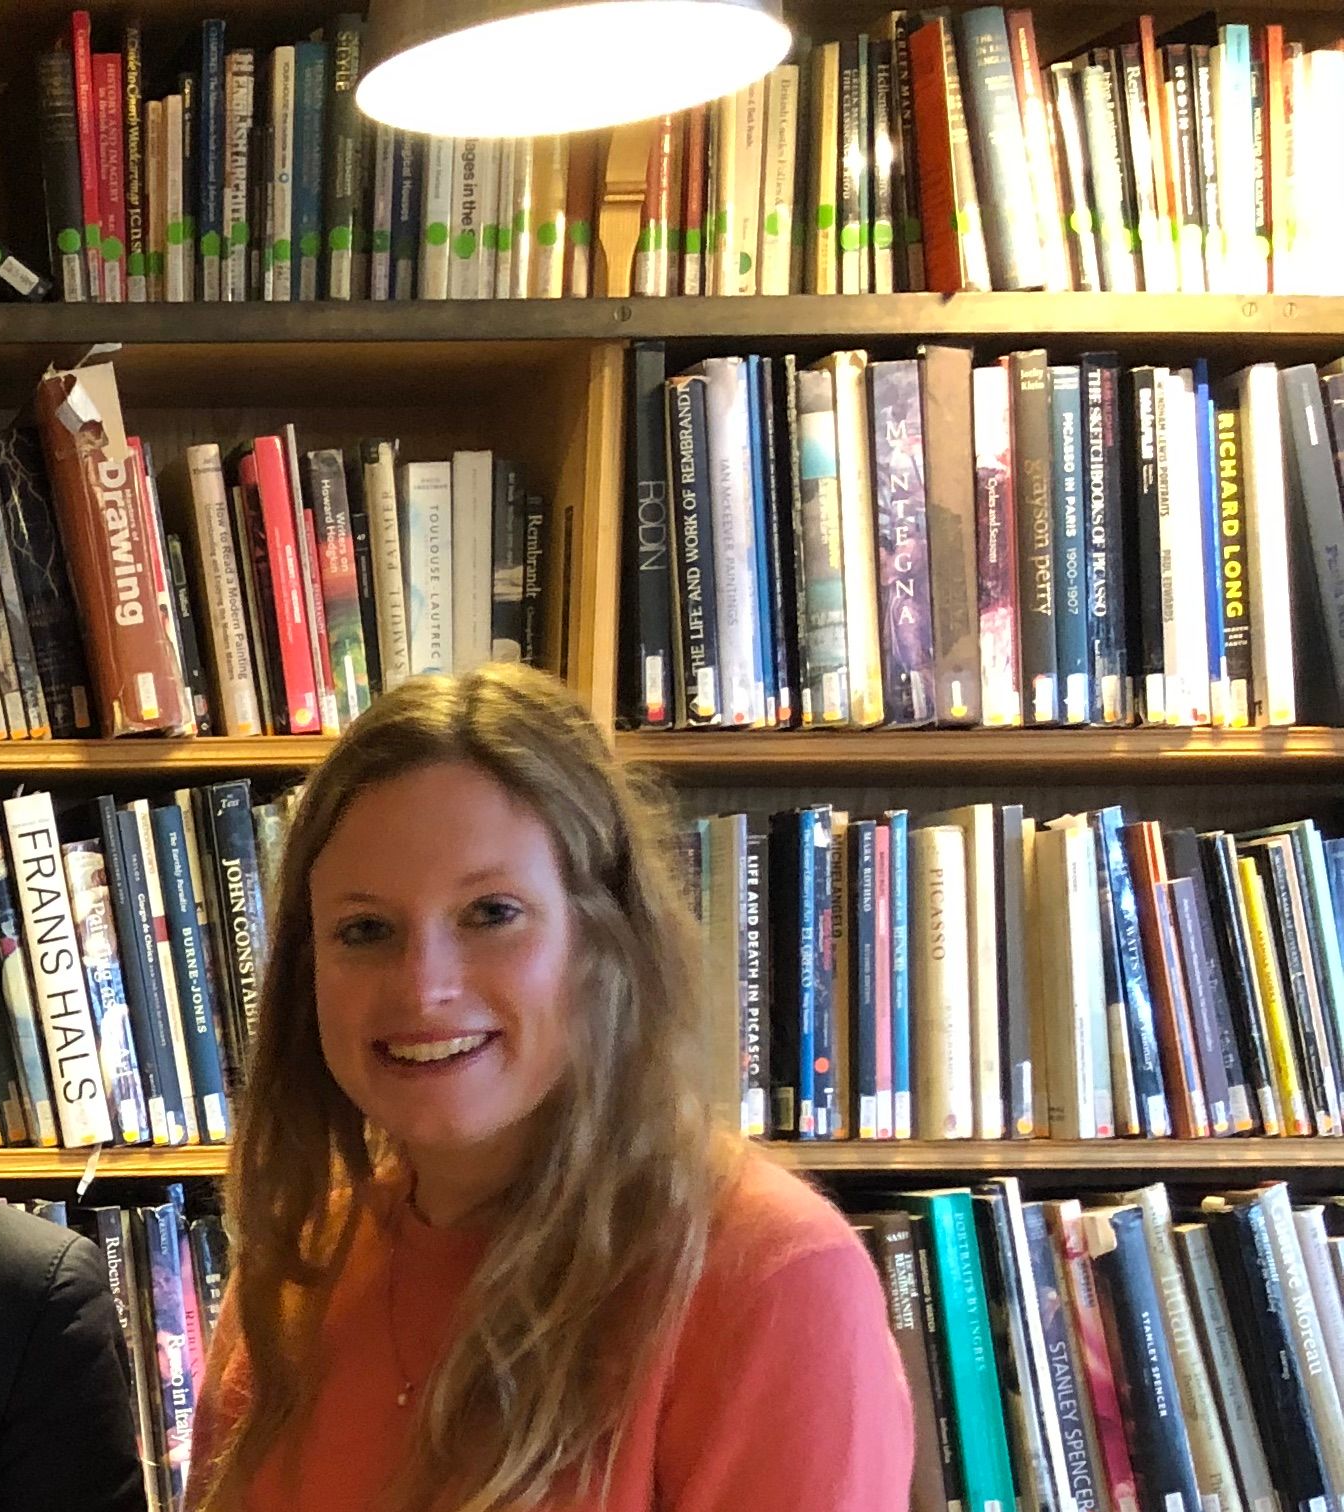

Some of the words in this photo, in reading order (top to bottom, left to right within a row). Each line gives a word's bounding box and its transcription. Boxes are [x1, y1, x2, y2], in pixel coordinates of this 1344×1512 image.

[461, 199, 477, 226] the
[462, 183, 478, 198] in
[1088, 369, 1102, 403] THE
[1062, 412, 1074, 472] PICASSO
[1088, 407, 1104, 522] SKETCHBOOKS
[1064, 478, 1075, 492] IN
[1217, 413, 1240, 536] RICHARD
[214, 502, 225, 528] How
[321, 480, 334, 523] Howard
[681, 488, 696, 510] OF
[1024, 459, 1052, 549] grayson
[1064, 496, 1076, 536] PARIS
[97, 460, 145, 626] Drawing
[220, 531, 229, 543] to
[325, 526, 338, 573] Hodgkin
[526, 514, 543, 598] Rembrandt
[683, 516, 700, 562] WORK
[1091, 524, 1105, 547] OF
[221, 546, 233, 574] Read
[1223, 546, 1243, 619] LONG
[227, 587, 241, 629] Modern
[686, 569, 702, 606] AND
[1025, 555, 1053, 616] perry
[1092, 553, 1107, 617] PICASSO
[688, 610, 704, 640] LIFE
[235, 633, 249, 680] Painting
[690, 644, 706, 675] THE
[222, 858, 247, 914] JOHN
[747, 855, 758, 884] LIFE
[832, 834, 843, 938] MICHELANGELO
[17, 827, 74, 975] FRANS
[747, 892, 759, 925] AND
[929, 867, 946, 961] PICASSO
[747, 930, 759, 978] DEATH
[181, 927, 207, 1034] BURNE-JONES
[748, 984, 760, 1002] IN
[45, 989, 98, 1105] HALS
[748, 1008, 760, 1075] PICASSO
[105, 1236, 120, 1294] Rubens
[953, 1212, 975, 1294] PORTRAITS
[1293, 1296, 1323, 1377] Moreau
[1142, 1311, 1156, 1361] STANLEY
[1152, 1367, 1167, 1417] SPENCER
[173, 1389, 190, 1405] in
[171, 1408, 193, 1441] Italy
[1049, 1341, 1077, 1421] STANLEY
[1064, 1428, 1096, 1510] SPENCER
